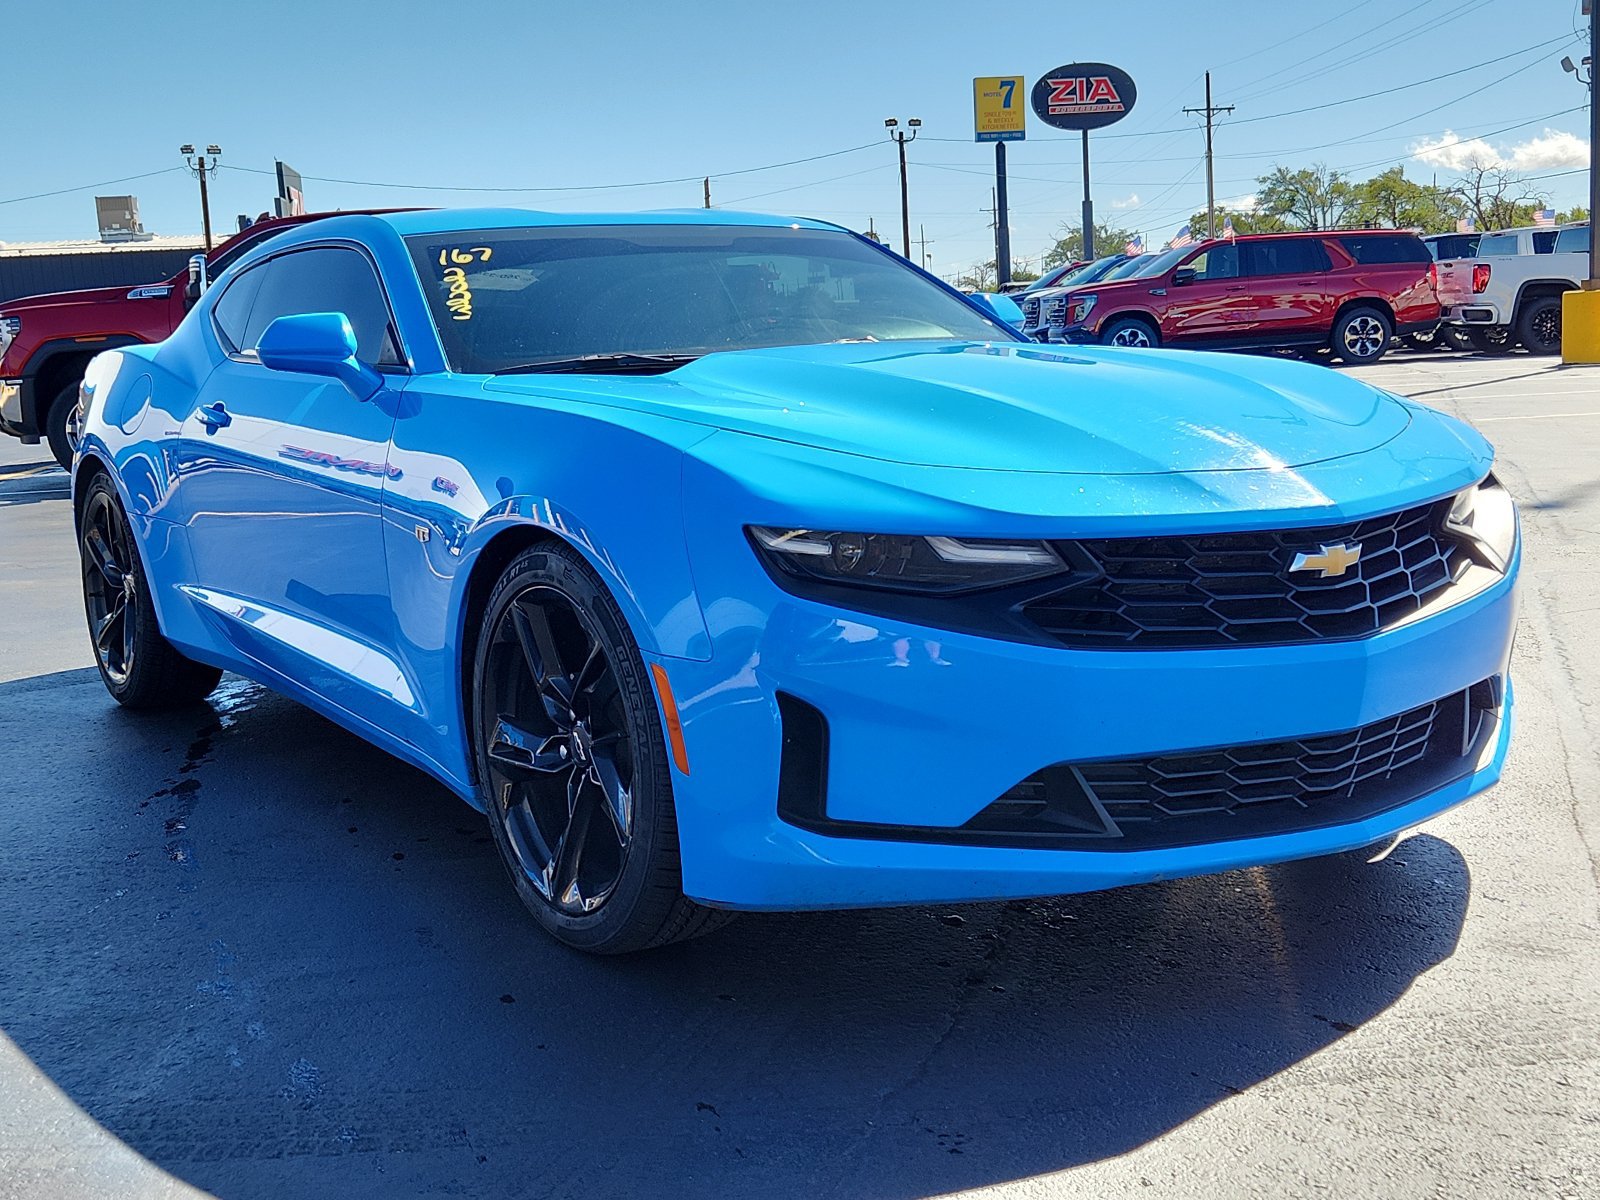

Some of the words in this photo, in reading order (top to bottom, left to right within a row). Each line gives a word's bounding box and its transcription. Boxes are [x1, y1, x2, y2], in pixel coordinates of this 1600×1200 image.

[999, 80, 1017, 109] 7
[1047, 76, 1121, 105] ZIA
[1055, 104, 1118, 113] POWERSPORTS
[439, 247, 492, 265] 167
[615, 644, 649, 759] GENERAL
